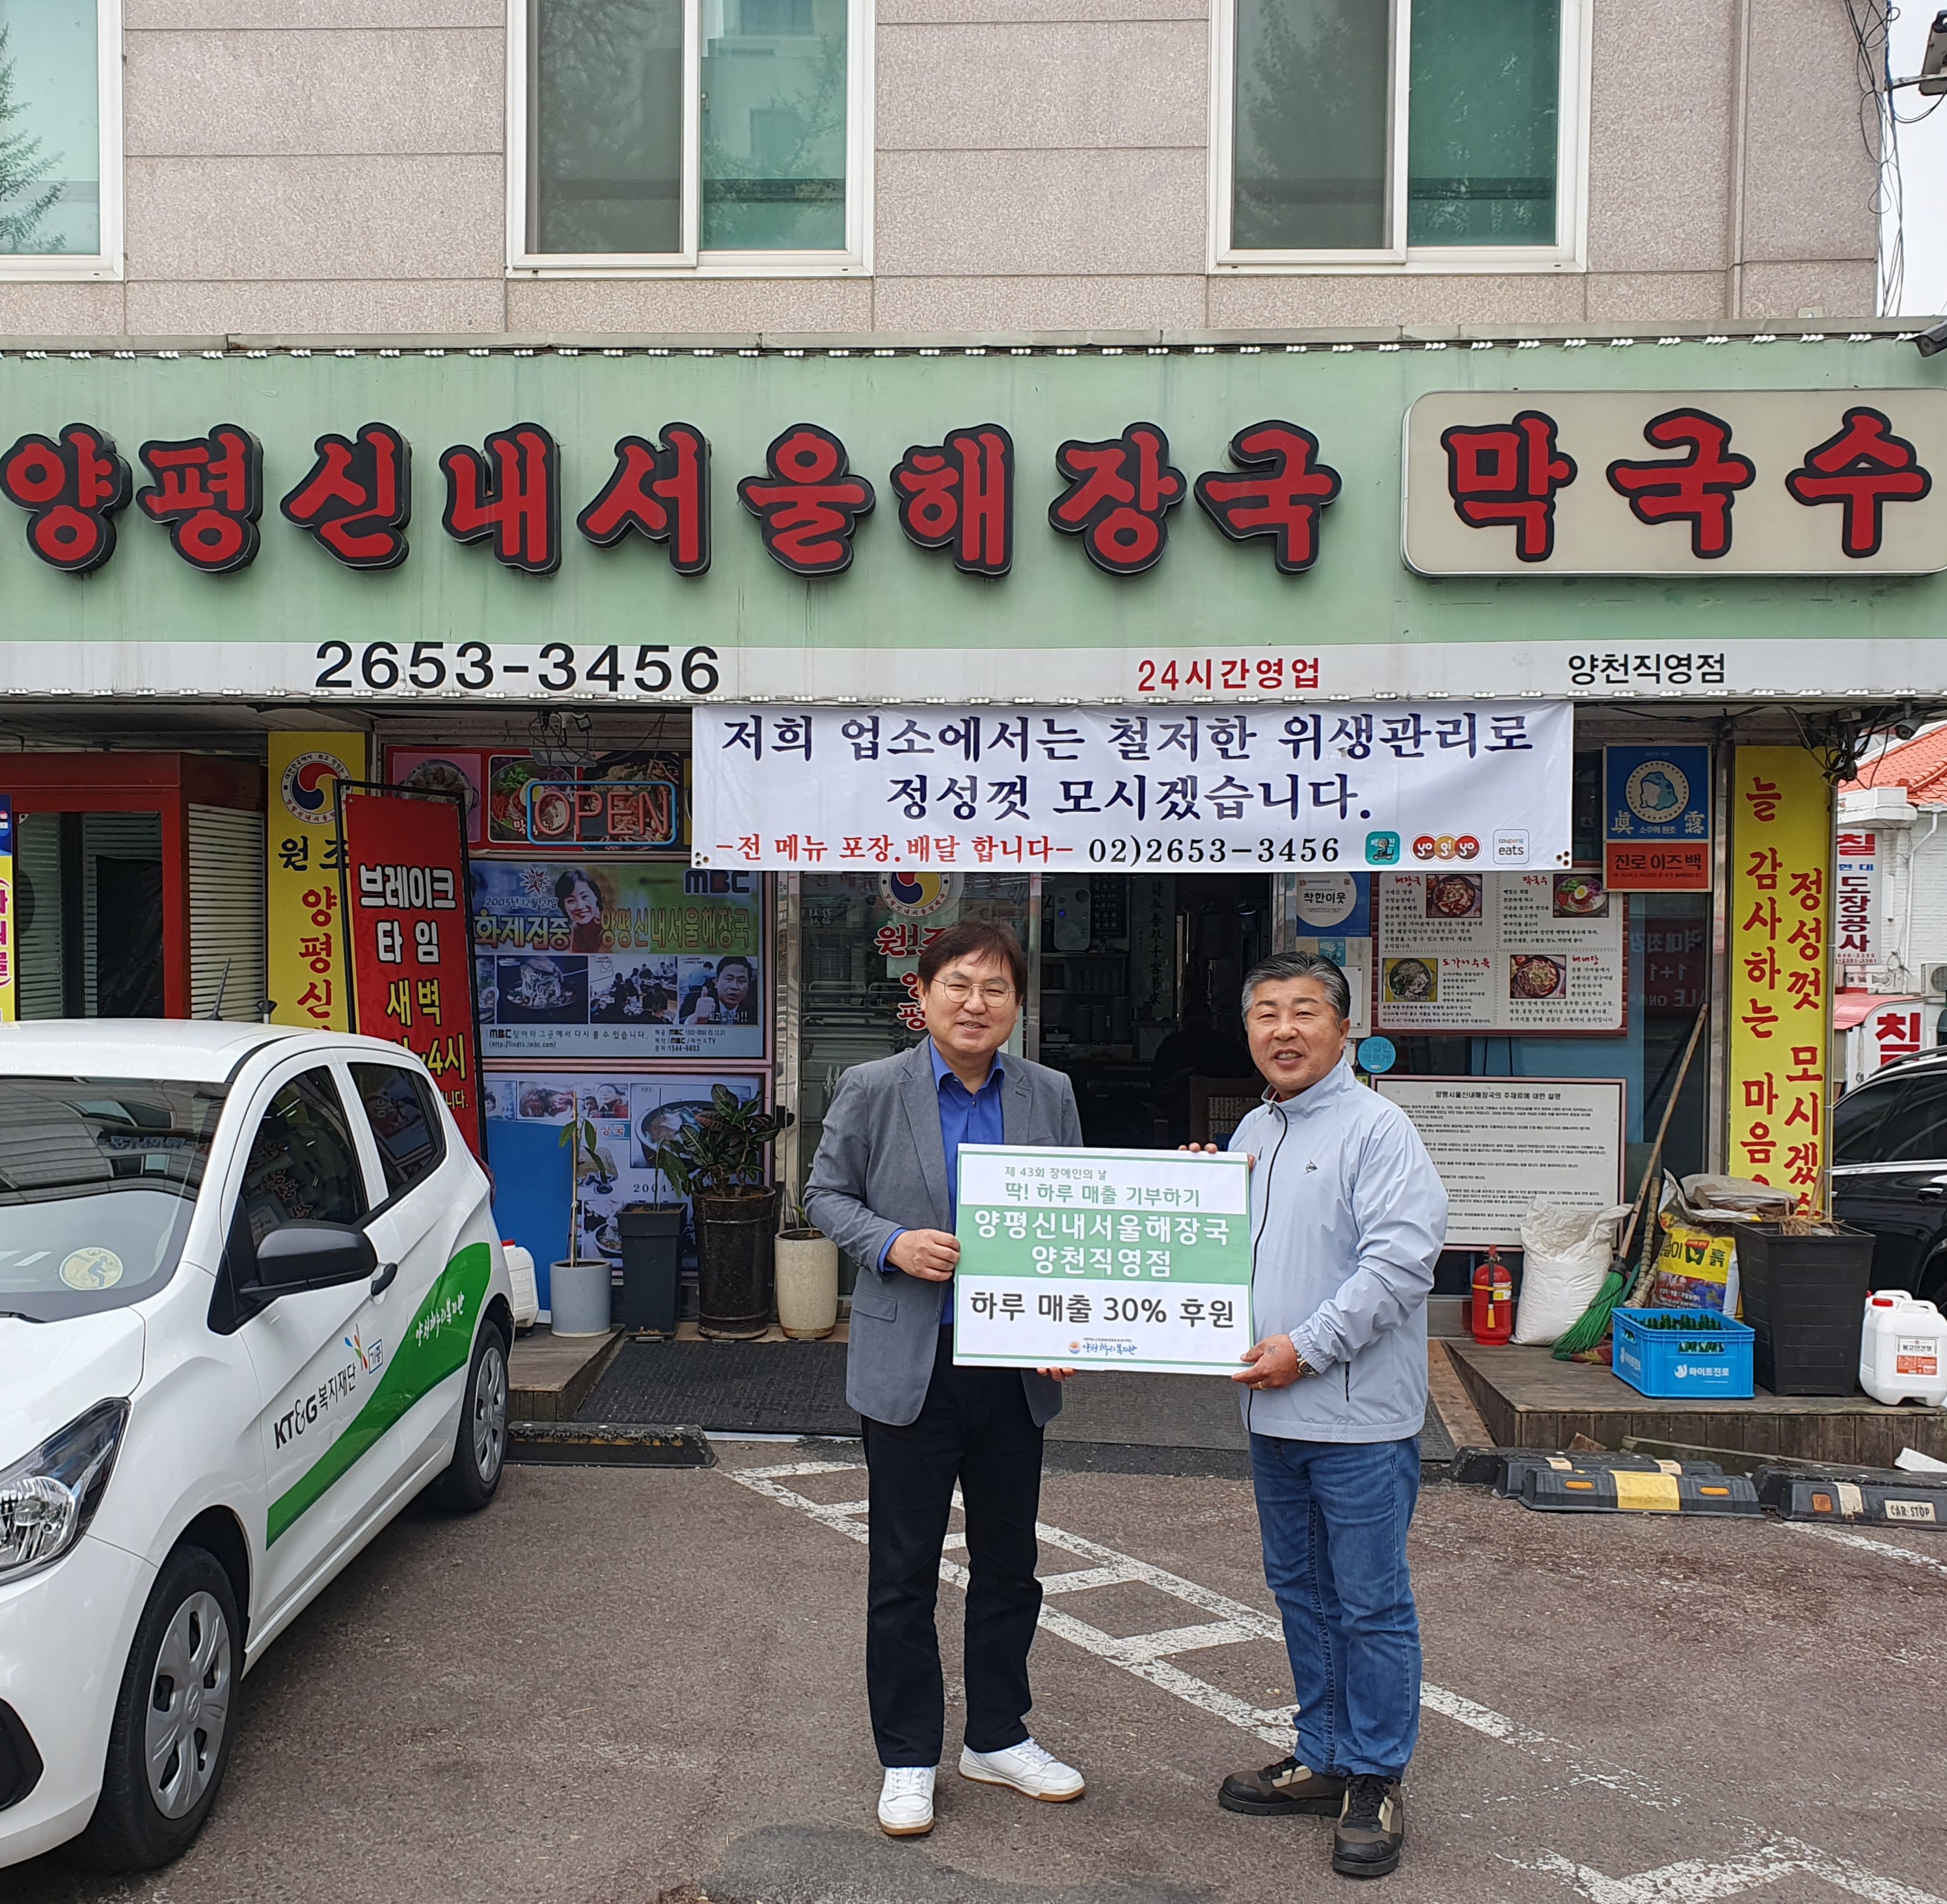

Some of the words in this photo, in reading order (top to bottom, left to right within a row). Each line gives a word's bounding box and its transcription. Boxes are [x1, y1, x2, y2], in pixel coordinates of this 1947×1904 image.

[0, 420, 1342, 577] 양평신내서울해장국
[1440, 407, 1931, 562] 막국수
[315, 640, 720, 695] 2653-3456
[1137, 657, 1320, 692] 24시간영업
[1568, 652, 1726, 685] 양천직영점
[722, 714, 813, 763] 저희
[841, 714, 1086, 763] 업소에서는
[1108, 714, 1257, 762] 철저한
[1278, 712, 1533, 761] 위생관리로
[534, 790, 670, 837] OPEN
[887, 774, 1030, 821] 정성껏
[1052, 773, 1372, 823] 모시겠습니다.
[1745, 776, 1782, 823] 늘
[774, 834, 829, 863] 메뉴
[1088, 834, 1340, 867] 02)2653-3456
[1499, 846, 1524, 856] eats
[1614, 854, 1646, 871] 진로
[1836, 834, 1876, 856] 칠
[685, 869, 751, 895] MBC
[1395, 875, 1421, 886] 해장국
[1523, 875, 1547, 886] 막국수
[1838, 864, 1874, 872] 현대
[359, 864, 456, 908] 브레이크
[485, 897, 520, 908] 2005년
[522, 897, 539, 908] 12월
[541, 897, 558, 909] 21일
[1303, 892, 1346, 904] 착한이웃
[474, 908, 571, 951] 화제집중
[600, 907, 750, 949] 양평신내서울해장국
[1837, 876, 1871, 952] 도장공사
[376, 919, 440, 963] 타임
[1743, 847, 1783, 1039] 감사하는
[1787, 867, 1823, 1010] 정성껏
[297, 886, 337, 1033] 양평신
[386, 978, 441, 1026] 새벽
[575, 1029, 590, 1039] 다시
[603, 1030, 609, 1039] 수
[1875, 1013, 1921, 1066] 칠
[1004, 1166, 1016, 1178] 제
[1019, 1167, 1045, 1179] 43회
[1049, 1167, 1093, 1180] 장애인의
[1098, 1169, 1108, 1181] 날
[1005, 1182, 1029, 1202] 딱!
[1037, 1183, 1074, 1203] 하루
[1082, 1184, 1117, 1205] 매출
[1126, 1187, 1201, 1208] 기부하기
[975, 1210, 1231, 1246] 양평신내서울해장국
[1031, 1245, 1171, 1278] 양천직영점
[1709, 1247, 1726, 1268] 흙
[970, 1292, 1026, 1322] 하루
[1038, 1294, 1093, 1323] 매출
[1103, 1297, 1167, 1324] 30%
[1178, 1299, 1234, 1329] 후원
[1689, 1367, 1730, 1376] 하이트진로
